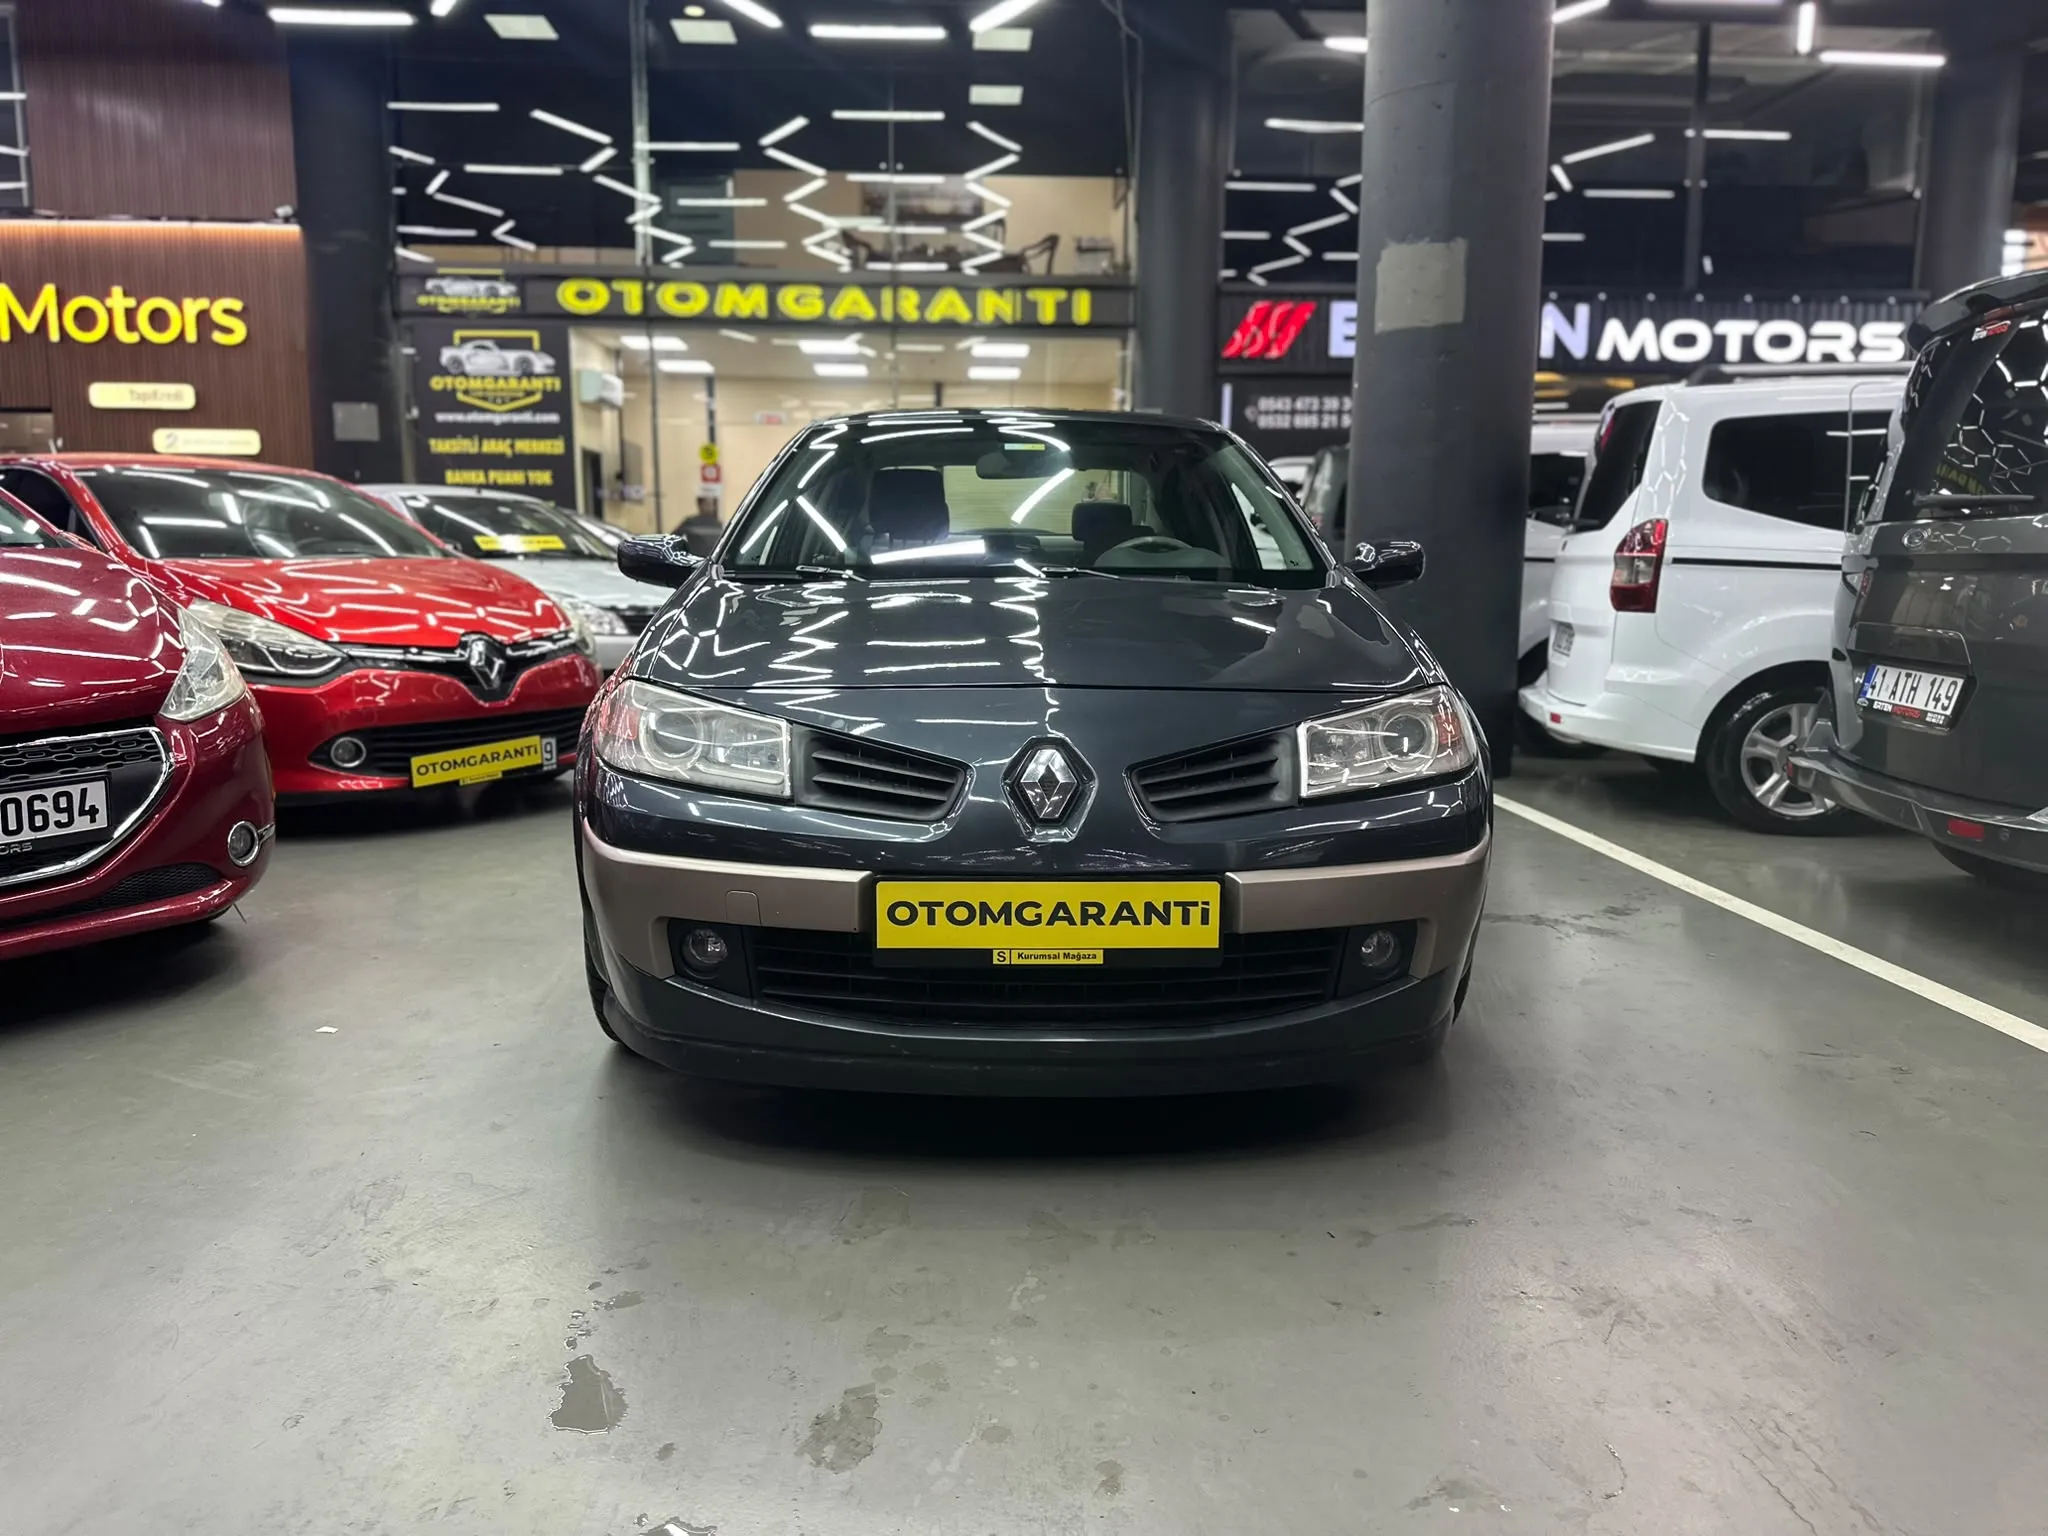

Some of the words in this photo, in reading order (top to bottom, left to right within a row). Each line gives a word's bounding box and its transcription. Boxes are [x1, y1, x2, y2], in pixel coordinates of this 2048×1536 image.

[0, 282, 248, 346] Motors
[556, 277, 1092, 325] OTOMGARANTI
[1596, 317, 1906, 363] MOTORS
[429, 375, 562, 392] OTOMGARANTI
[1870, 667, 1888, 697] 41
[1888, 671, 1922, 705] ATH
[1924, 677, 1958, 712] 149
[544, 741, 554, 762] 9
[0, 787, 100, 837] 0694
[996, 950, 1007, 962] S
[1017, 951, 1060, 961] Kurumsal
[1063, 951, 1097, 962] Mağaza
